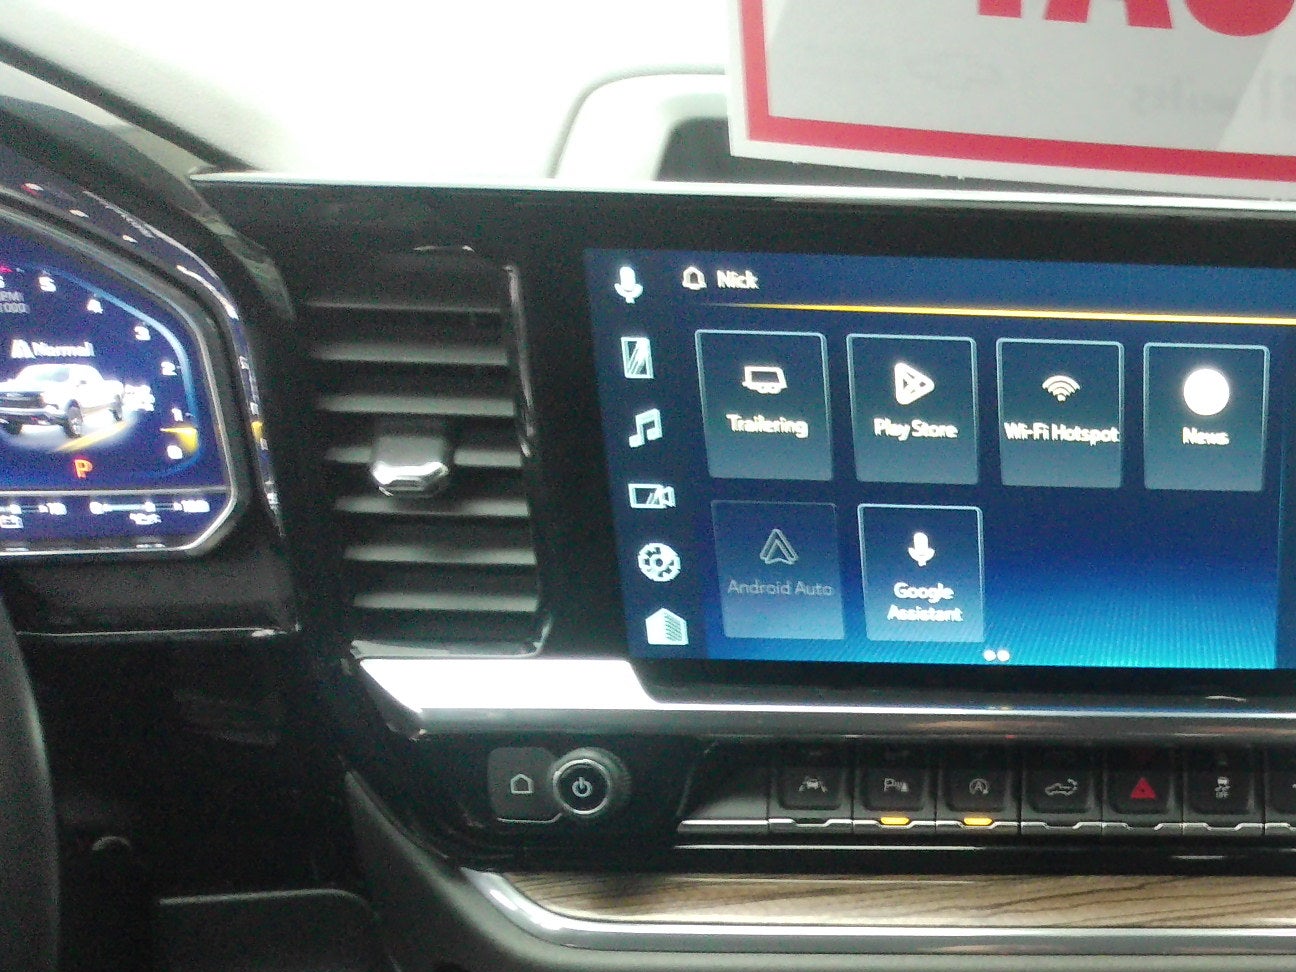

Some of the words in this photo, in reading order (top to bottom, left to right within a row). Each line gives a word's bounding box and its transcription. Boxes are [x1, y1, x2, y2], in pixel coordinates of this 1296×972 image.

[726, 413, 809, 439] Trailering
[873, 417, 911, 441] Play
[911, 418, 959, 438] Store
[1003, 421, 1050, 441] Wi-Fi
[1051, 423, 1121, 446] Hotspot
[1182, 426, 1230, 445] News
[74, 459, 93, 479] P
[727, 579, 791, 595] Android
[794, 580, 833, 596] Auto
[893, 581, 955, 604] Google
[886, 604, 964, 622] Assistant
